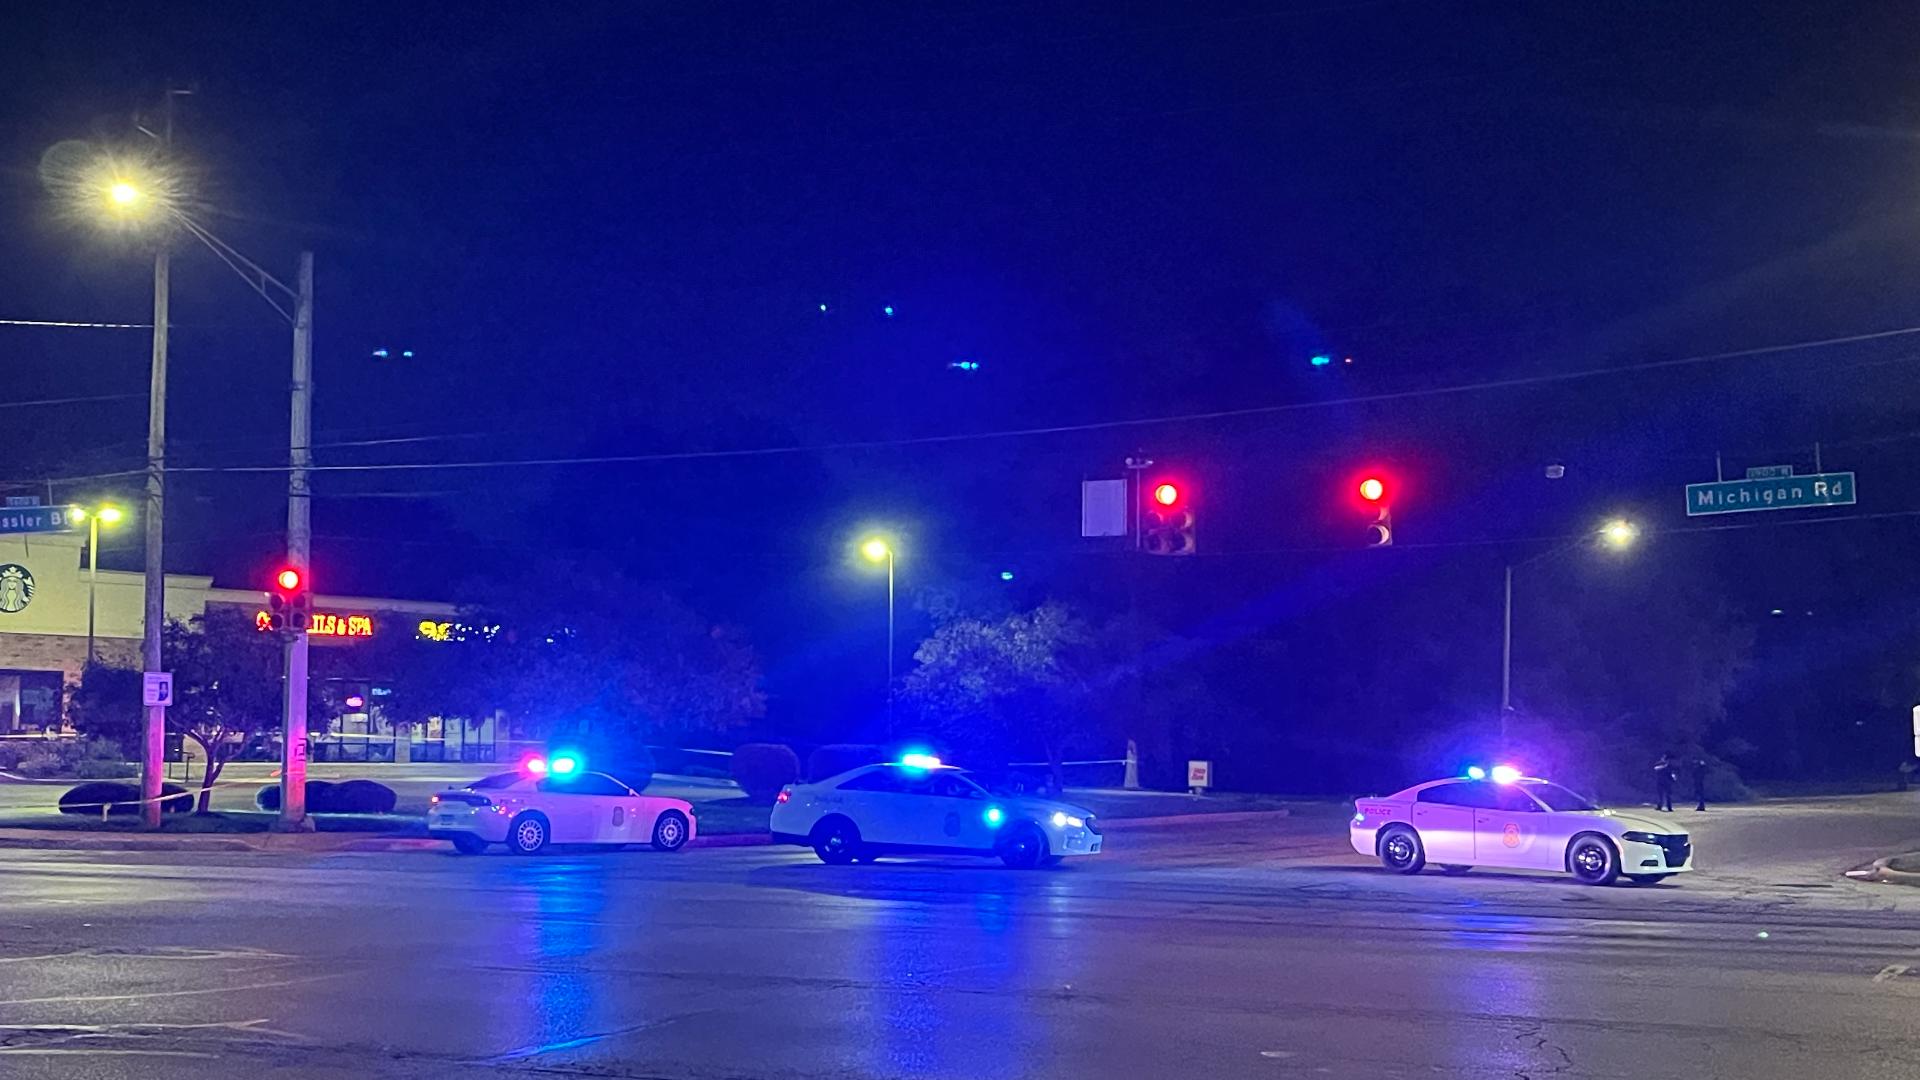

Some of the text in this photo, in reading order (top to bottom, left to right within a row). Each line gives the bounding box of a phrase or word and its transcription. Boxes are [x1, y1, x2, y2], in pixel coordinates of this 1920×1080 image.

[1697, 481, 1842, 506] Michigan Rd
[1, 513, 42, 528] ssler
[306, 614, 336, 634] ILS
[347, 614, 372, 636] SPA
